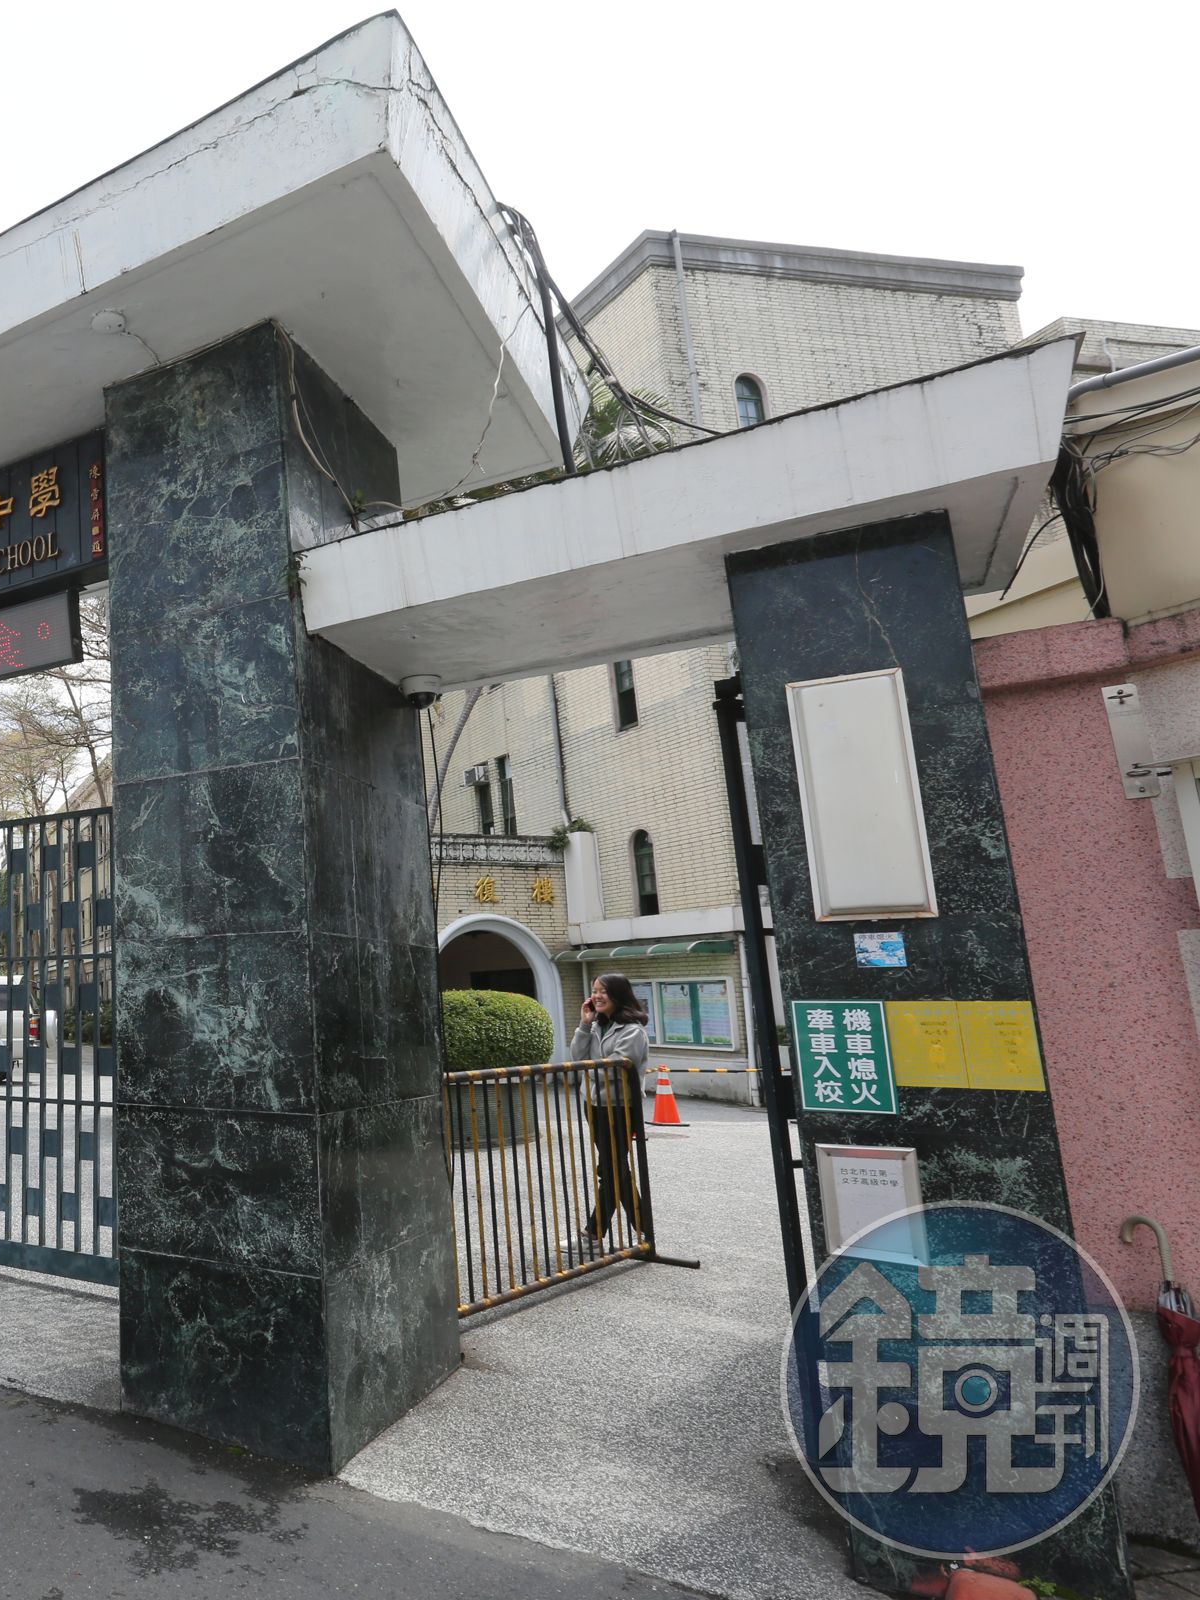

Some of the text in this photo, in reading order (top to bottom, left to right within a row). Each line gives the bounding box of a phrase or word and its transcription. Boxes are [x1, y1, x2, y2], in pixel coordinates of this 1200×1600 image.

[806, 1008, 844, 1105] 牽車入校
[843, 1008, 881, 1106] 機車熄火
